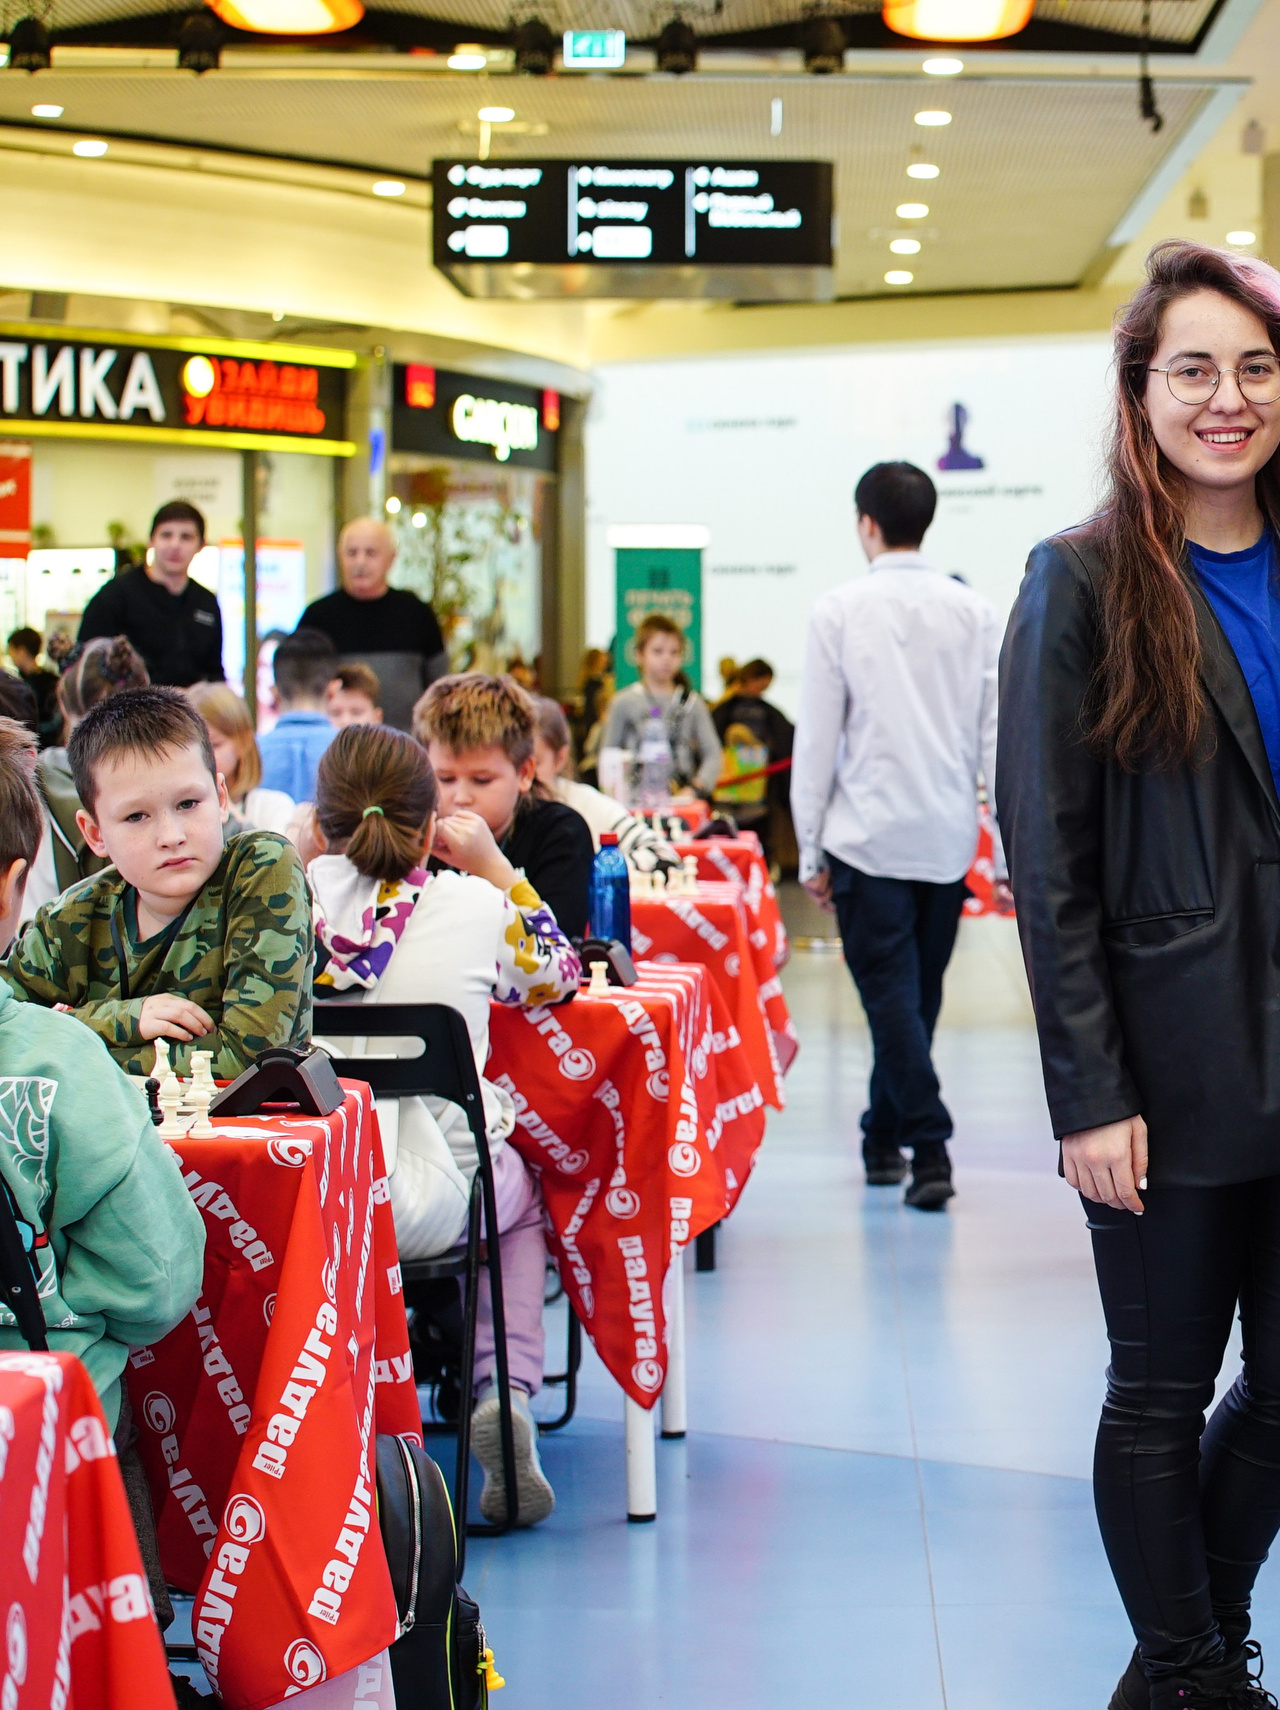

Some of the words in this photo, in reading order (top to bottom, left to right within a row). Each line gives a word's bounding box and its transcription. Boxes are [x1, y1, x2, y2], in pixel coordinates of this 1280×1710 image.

[0, 341, 166, 423] ТИКА
[617, 1234, 658, 1361] радуга
[252, 1302, 338, 1480] радуга
